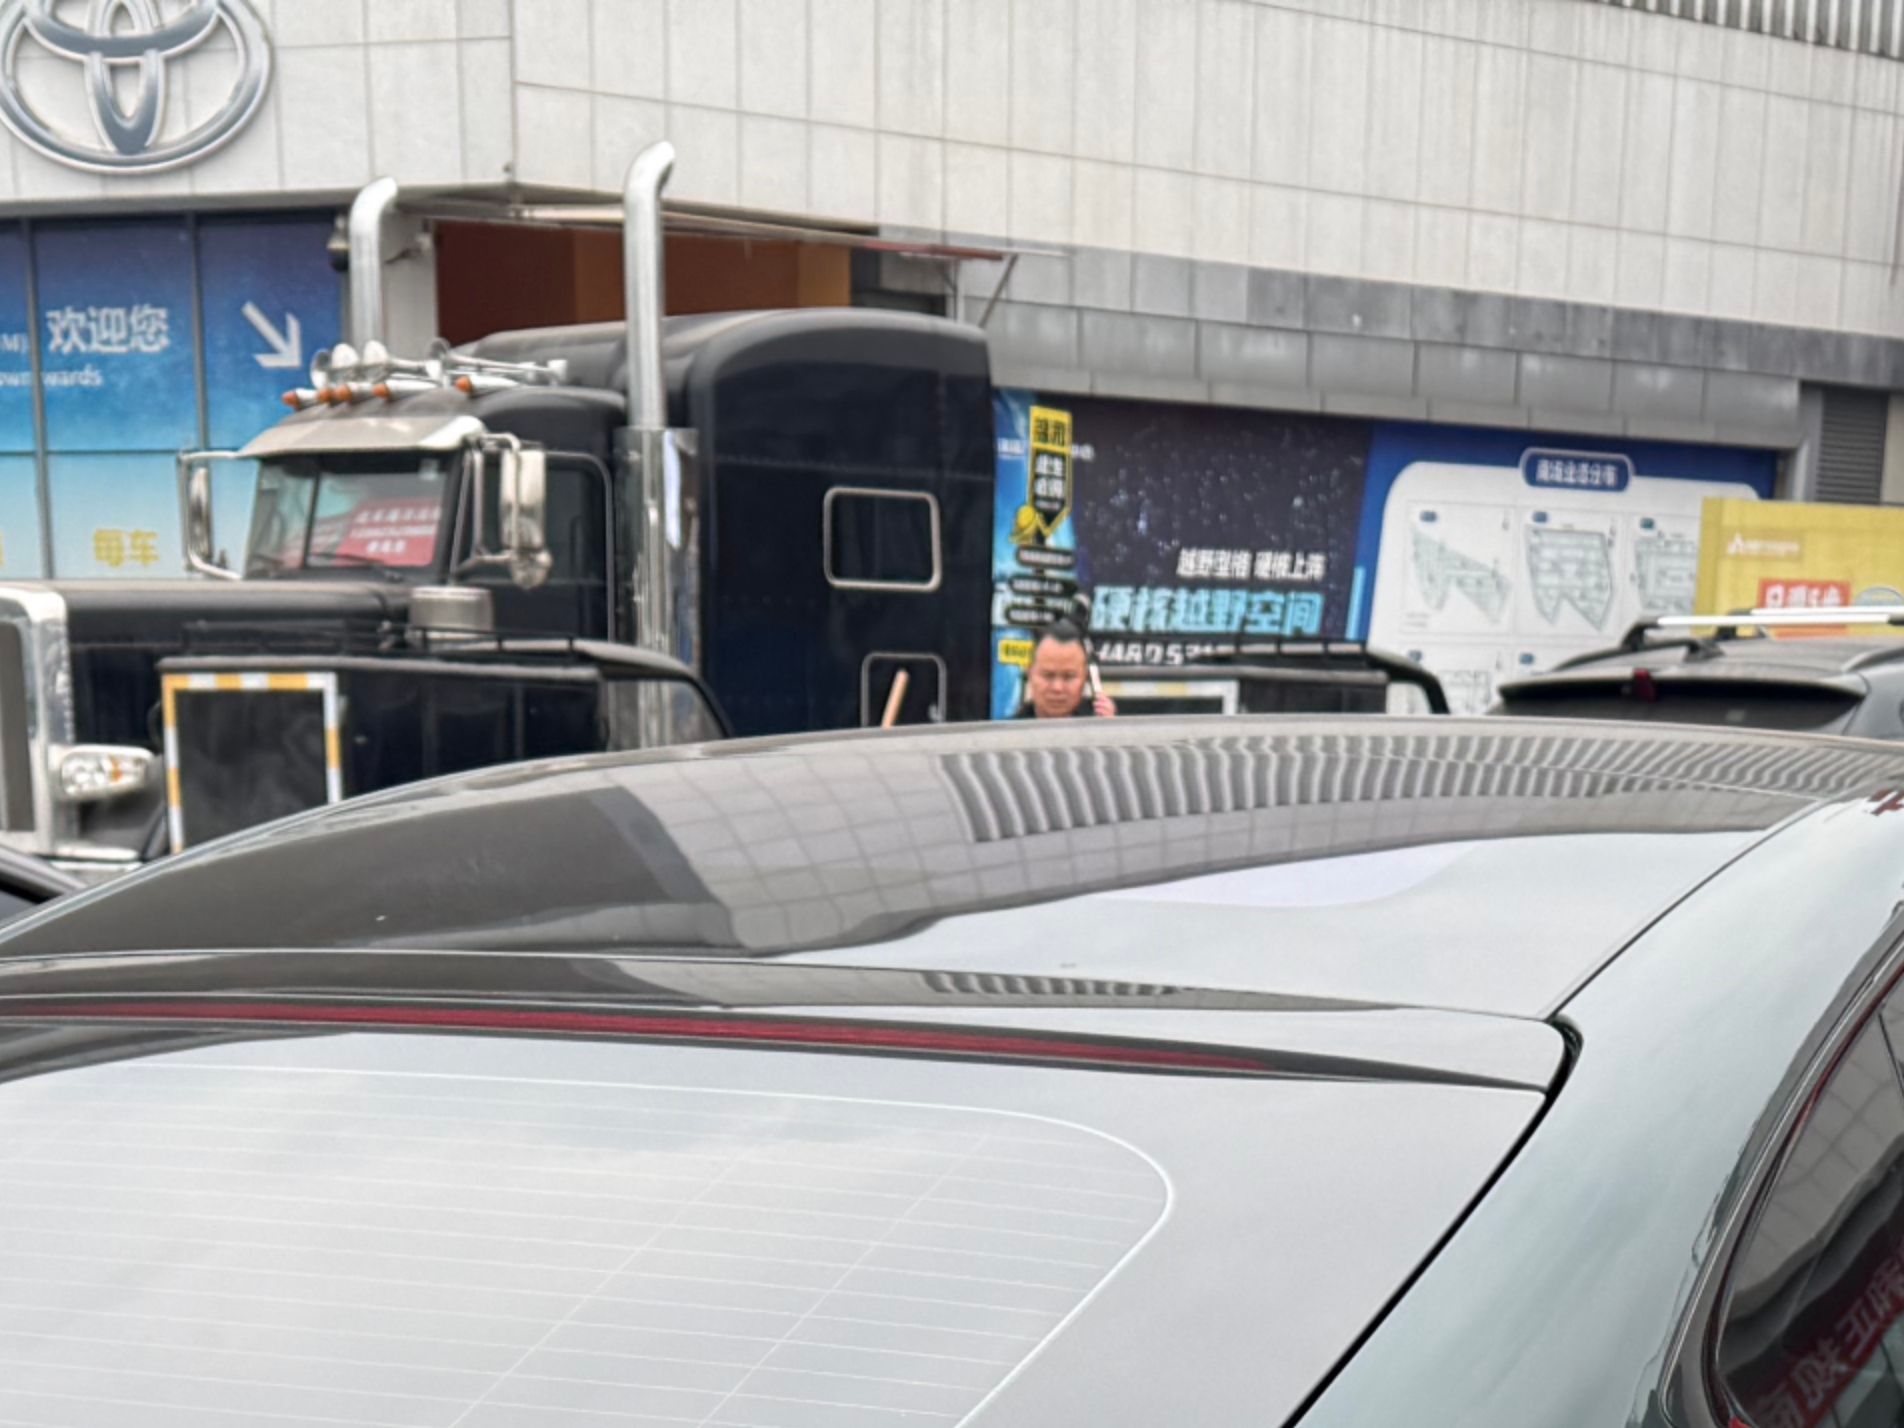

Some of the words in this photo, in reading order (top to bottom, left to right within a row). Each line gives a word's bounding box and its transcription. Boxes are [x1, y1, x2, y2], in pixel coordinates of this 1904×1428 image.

[45, 304, 170, 354] 欢迎您
[1089, 584, 1325, 637] 硬核越野空间
